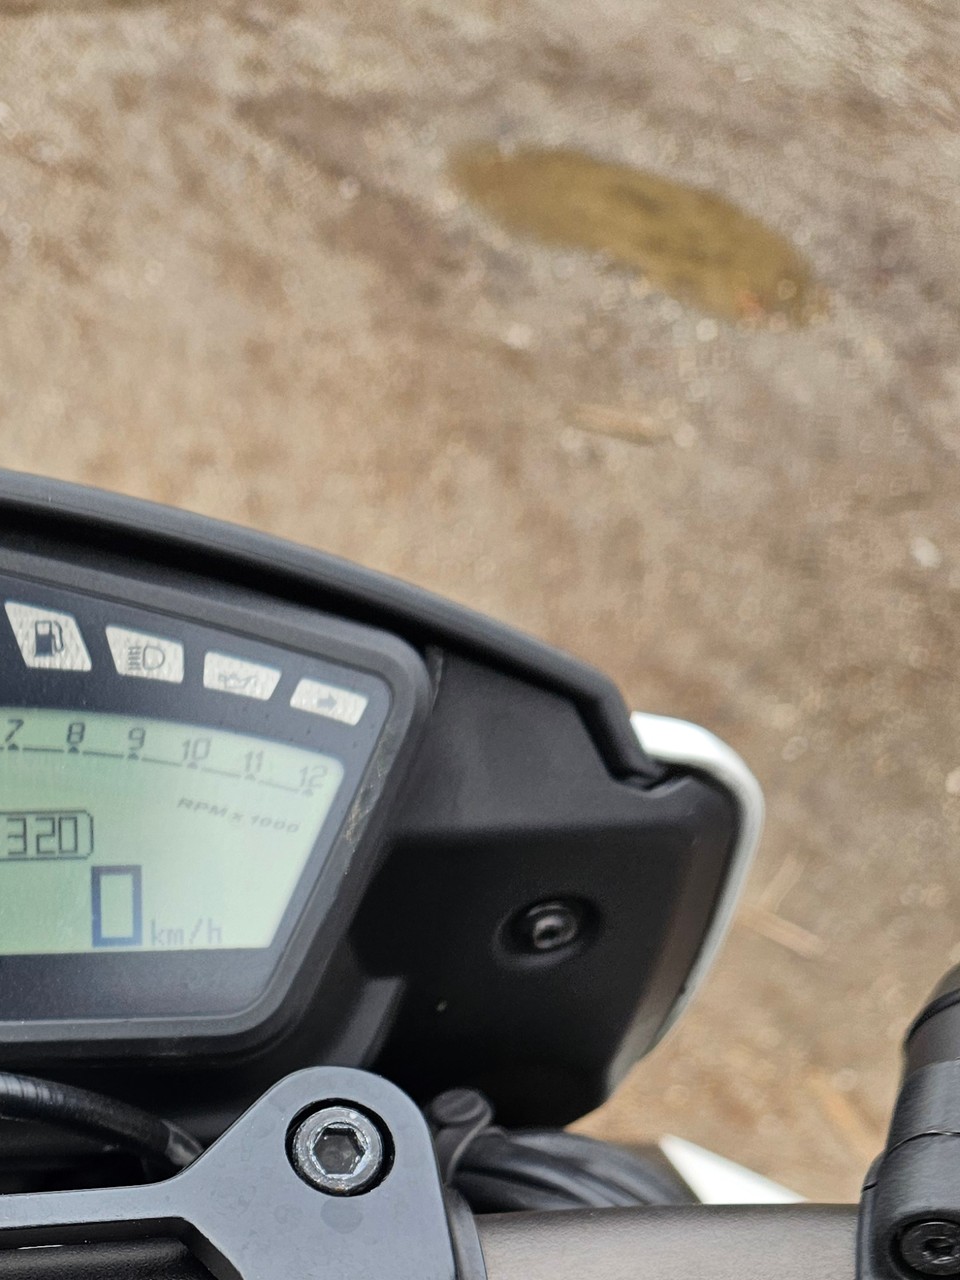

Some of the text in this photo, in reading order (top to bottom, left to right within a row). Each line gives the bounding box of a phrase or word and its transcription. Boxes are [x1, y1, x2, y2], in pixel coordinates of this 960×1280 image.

[6, 718, 24, 743] 7
[66, 721, 86, 744] 8
[127, 726, 147, 750] 9
[181, 736, 212, 761] 10
[243, 750, 265, 774] 11
[299, 764, 329, 789] 12
[7, 816, 79, 856] 320
[177, 797, 228, 817] RPM
[250, 815, 301, 834] 1000
[91, 865, 223, 947] 0 km/h
